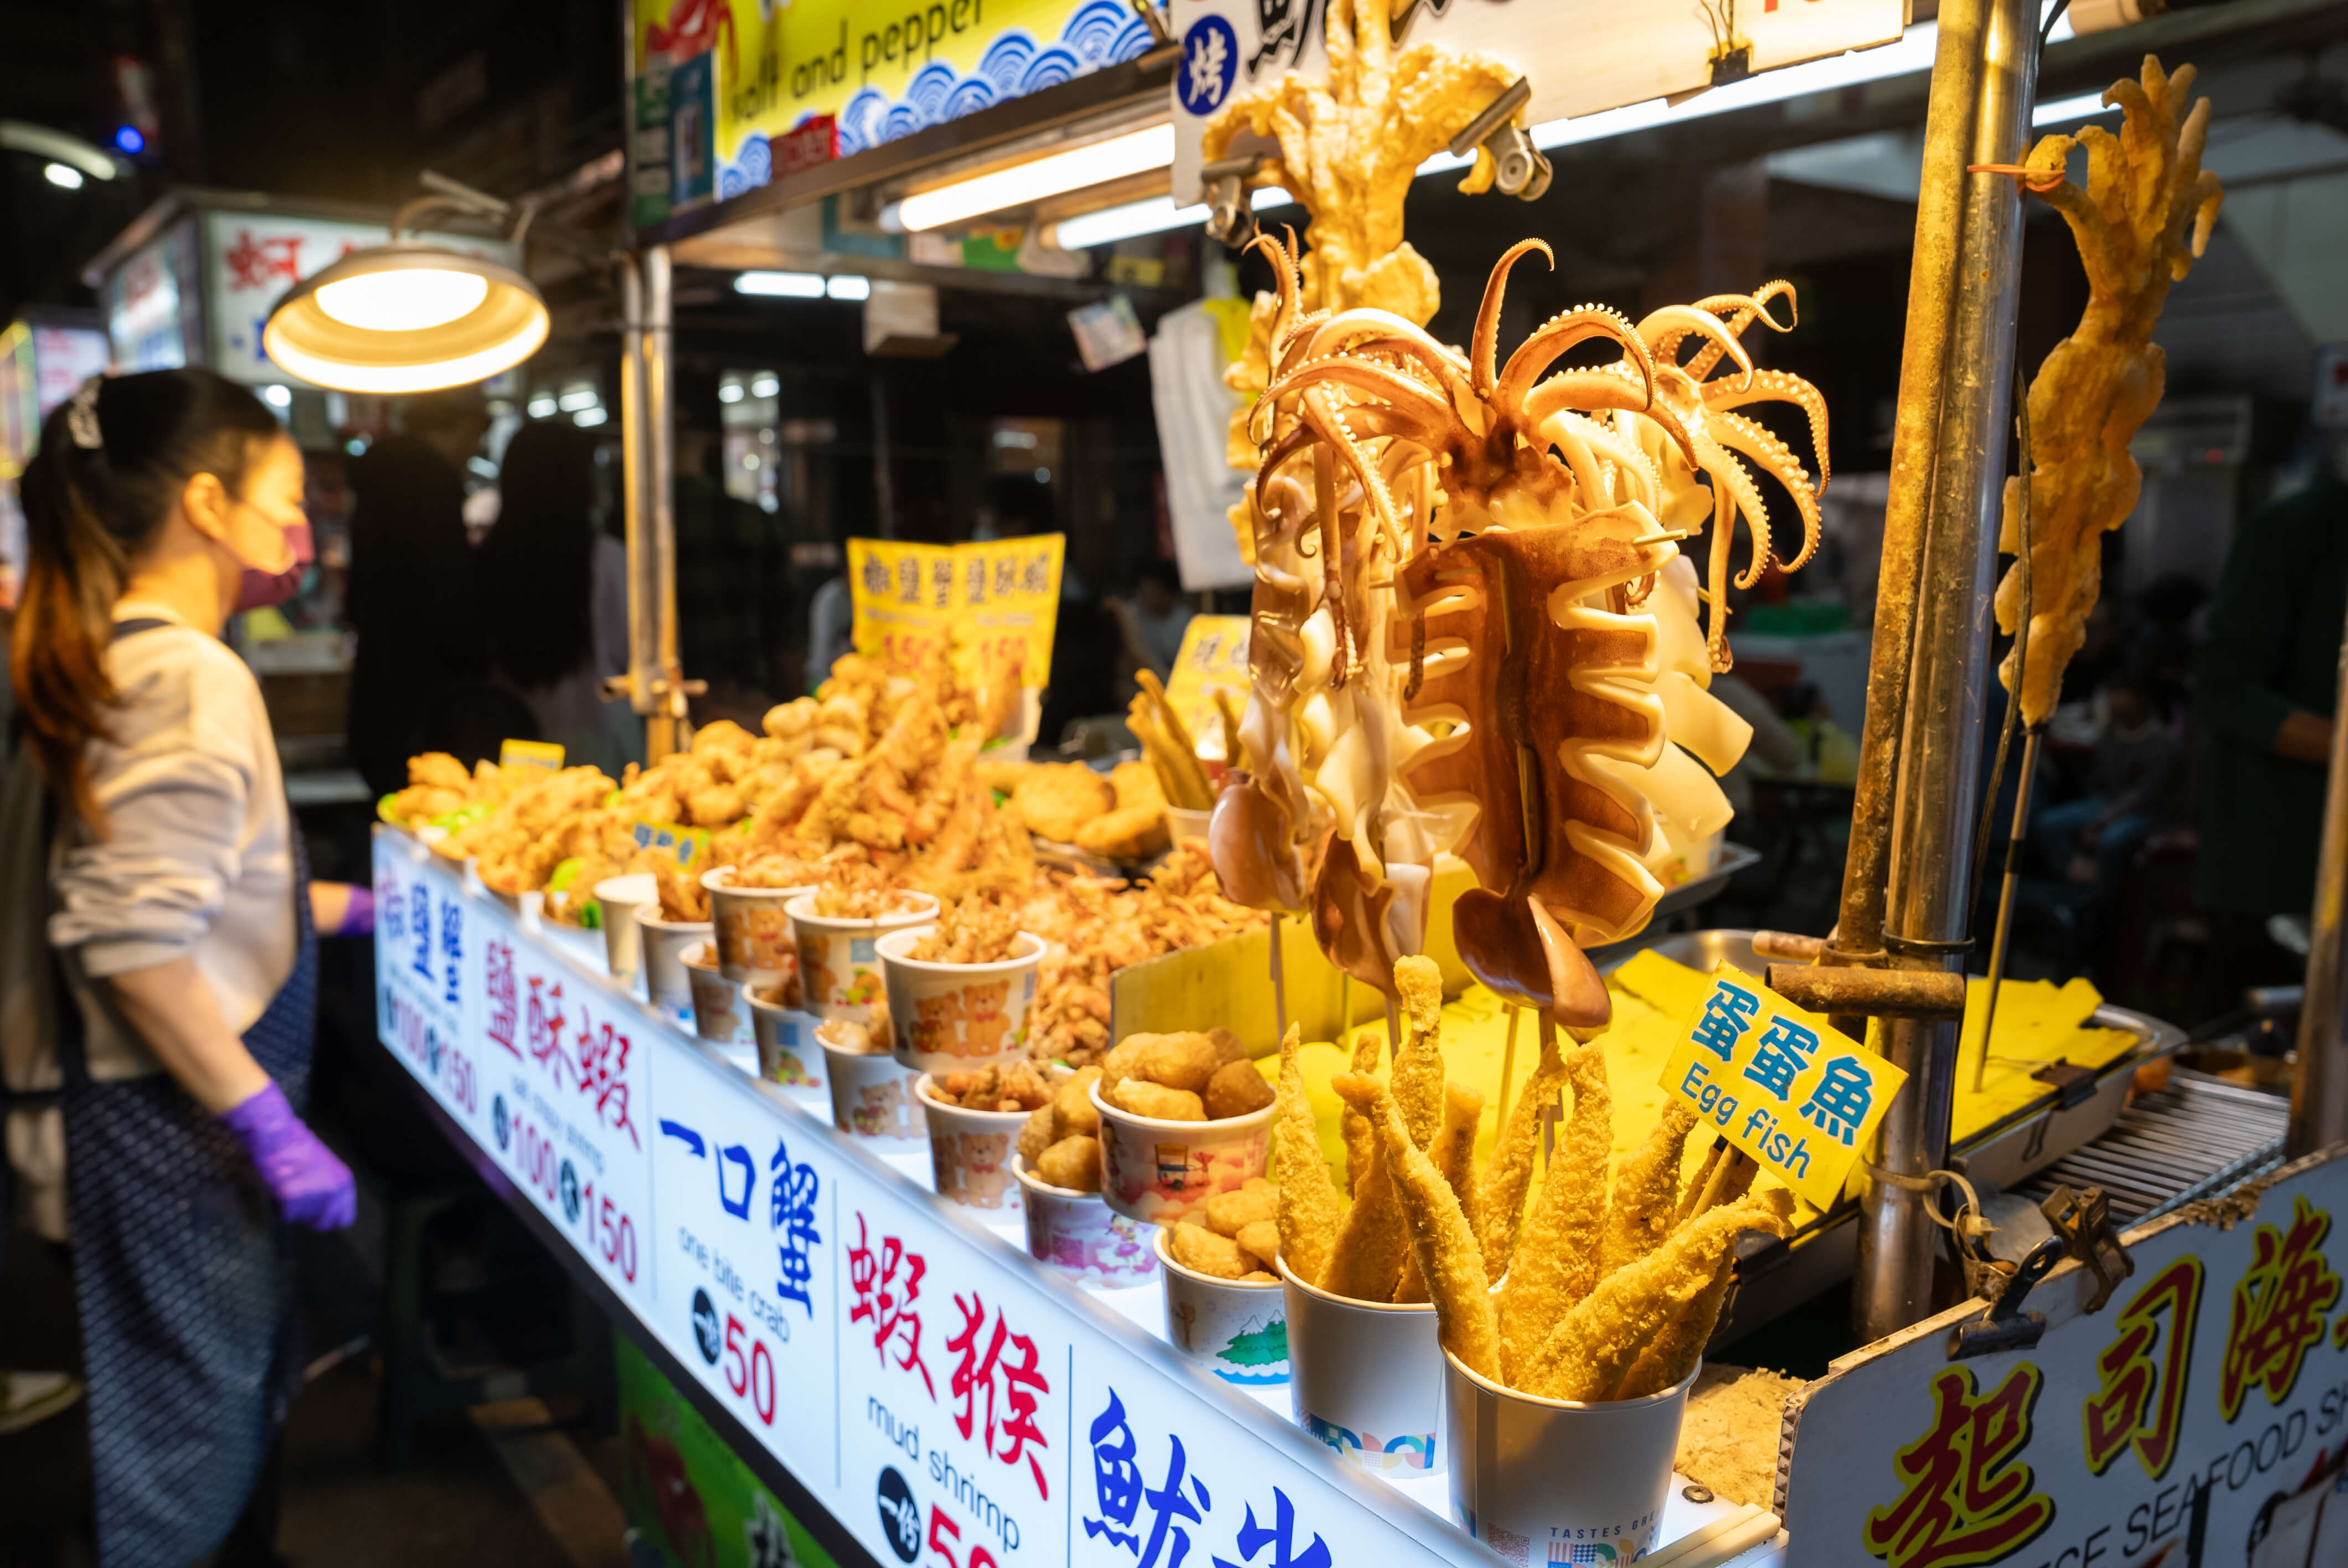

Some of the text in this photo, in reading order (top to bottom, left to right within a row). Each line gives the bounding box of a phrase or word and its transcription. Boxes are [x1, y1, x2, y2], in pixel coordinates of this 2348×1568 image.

[791, 19, 847, 100] and
[486, 937, 641, 1154] 鹽酥蝦
[1691, 981, 1872, 1146] 蛋蛋魚
[513, 1113, 557, 1201] 100
[1681, 1061, 1811, 1179] Egg fish
[583, 1181, 637, 1283] 150
[660, 1118, 821, 1319] 一口蟹
[678, 1226, 791, 1344] one bite crab
[725, 1311, 775, 1426] 50
[846, 1210, 1049, 1501] 蝦猴
[1862, 1194, 2348, 1568] 起司海
[867, 1394, 1020, 1552] mud shrimp
[1551, 1509, 1657, 1539] TASTES GRE
[2123, 1409, 2307, 1557] SEAFOOD
[926, 1501, 998, 1568] 5
